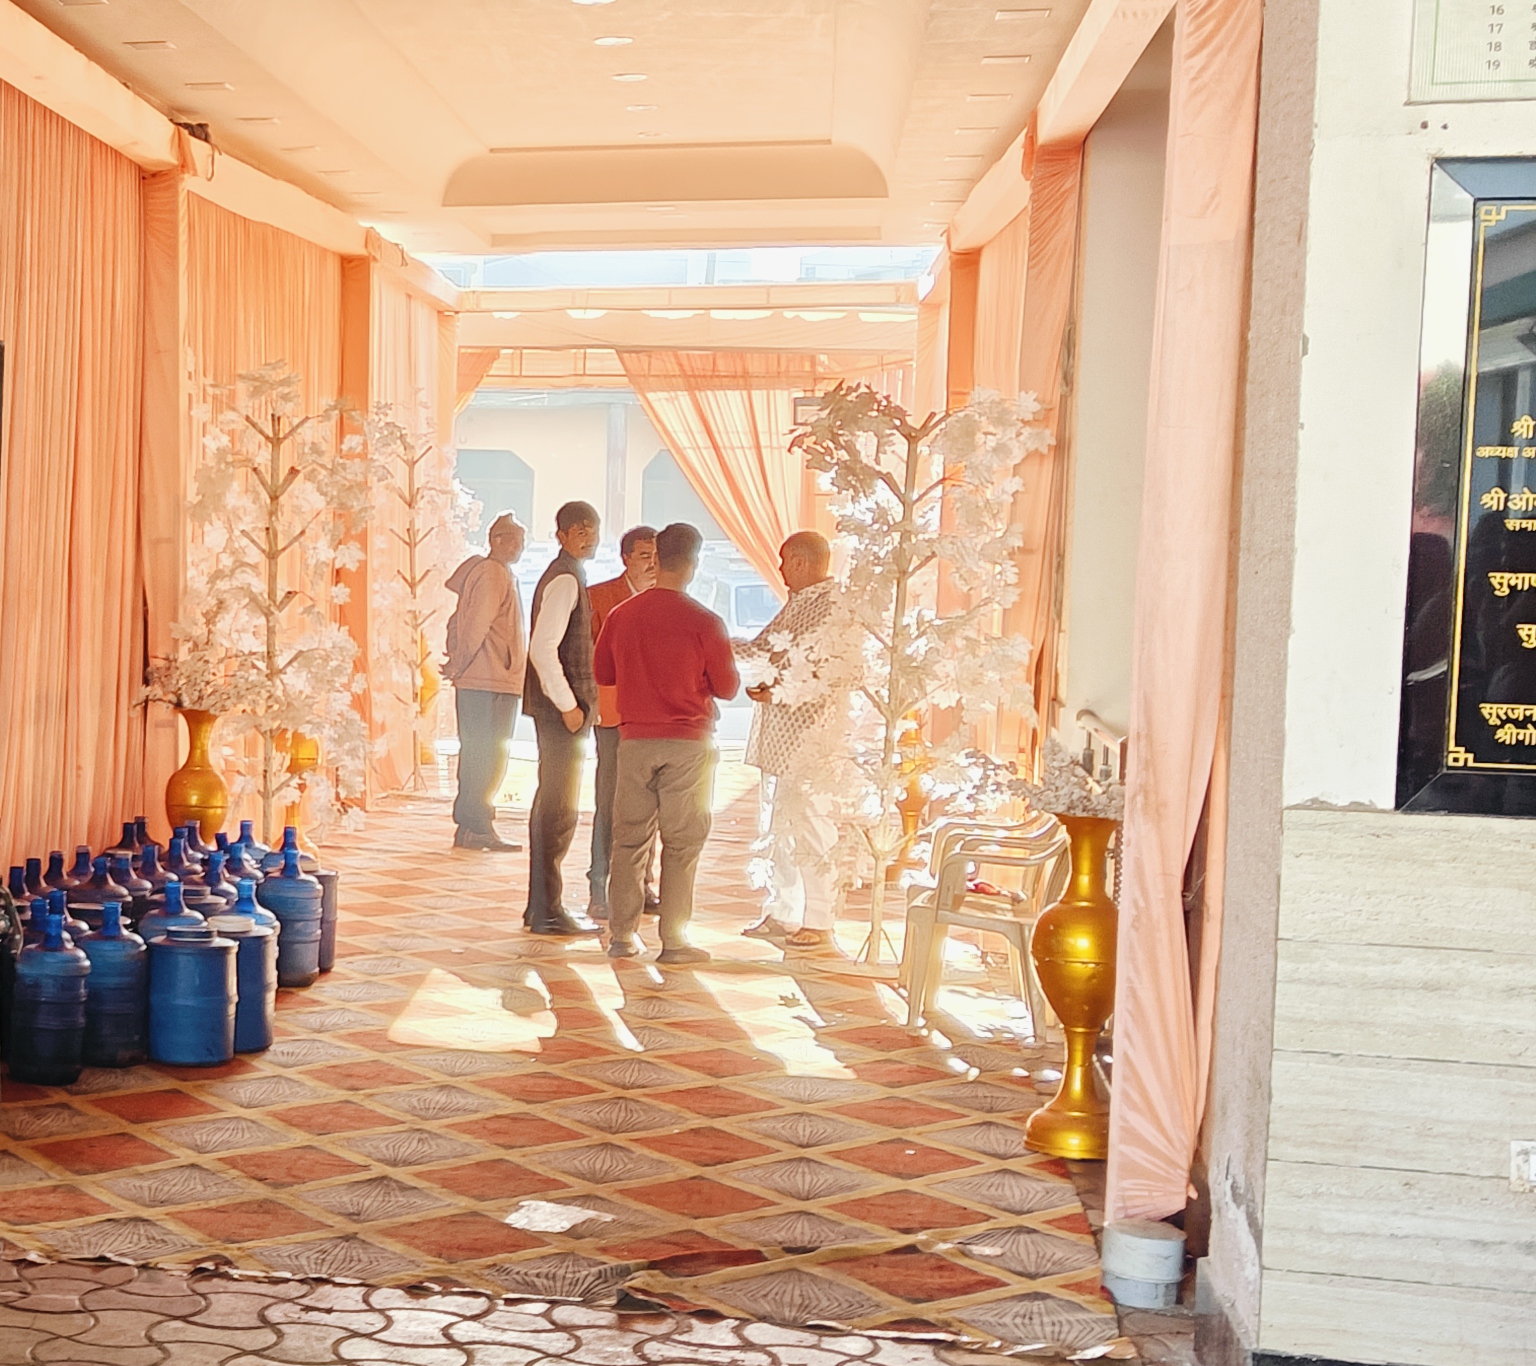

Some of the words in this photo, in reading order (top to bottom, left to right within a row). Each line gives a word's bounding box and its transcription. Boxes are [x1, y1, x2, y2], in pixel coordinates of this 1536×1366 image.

[1489, 4, 1505, 15] 16
[1488, 23, 1504, 34] 17
[1486, 41, 1502, 52] 18
[1485, 59, 1501, 70] 19
[1510, 414, 1536, 439] श्री
[1479, 487, 1508, 511] श्री
